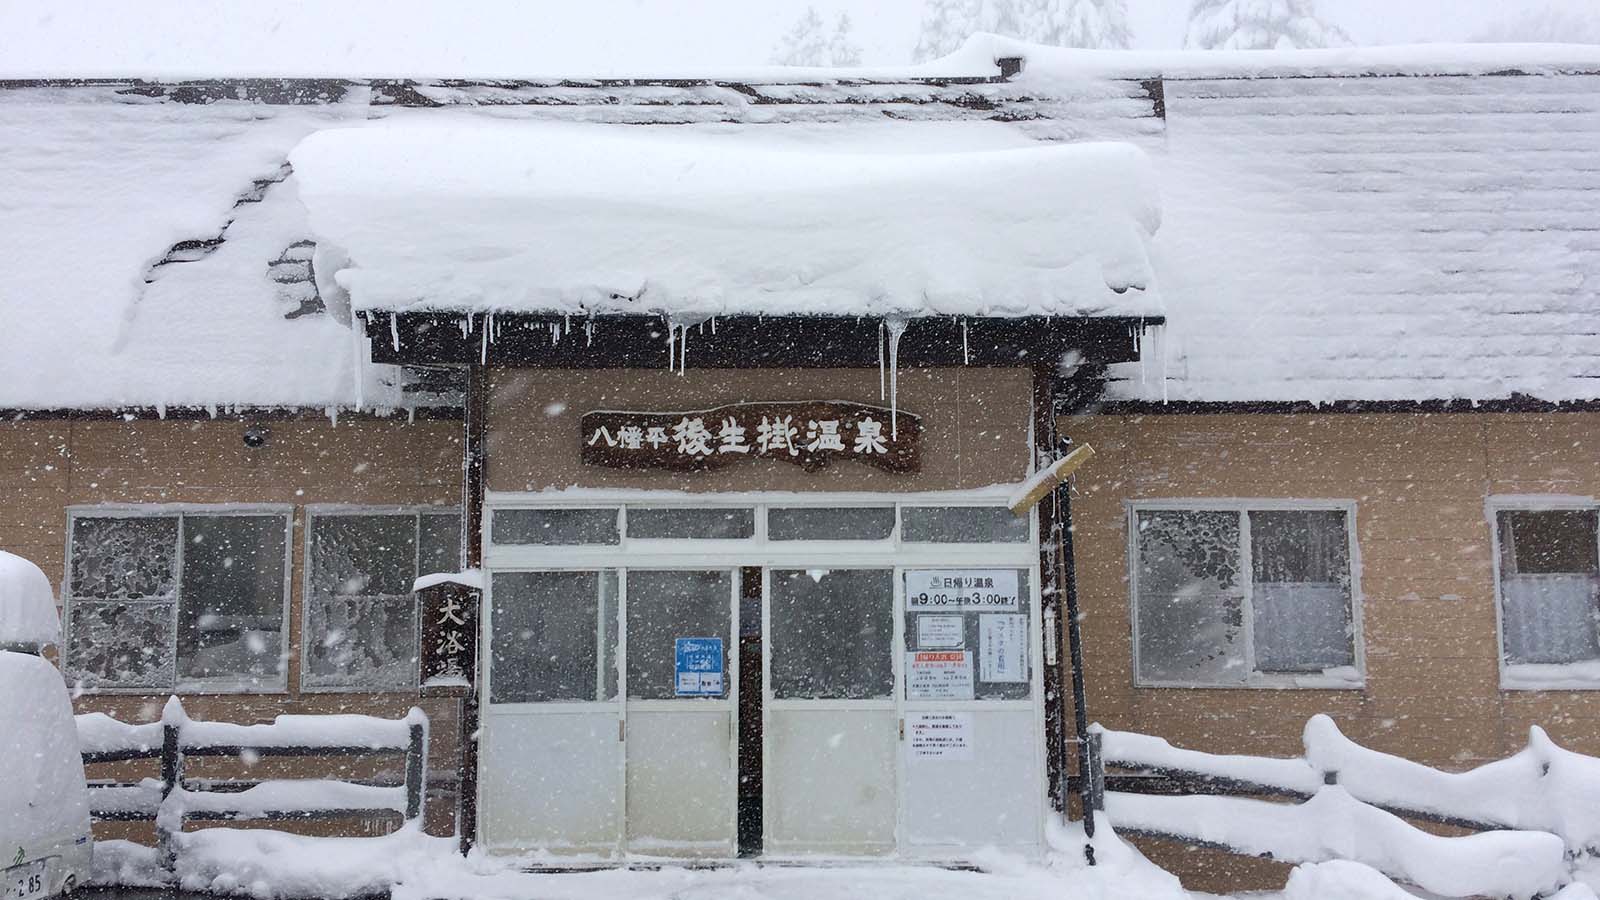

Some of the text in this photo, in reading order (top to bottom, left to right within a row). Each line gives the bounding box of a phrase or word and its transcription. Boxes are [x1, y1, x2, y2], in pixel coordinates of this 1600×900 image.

[588, 414, 889, 456] 八幡平 後生掛温泉
[943, 577, 994, 589] 日帰り温泉
